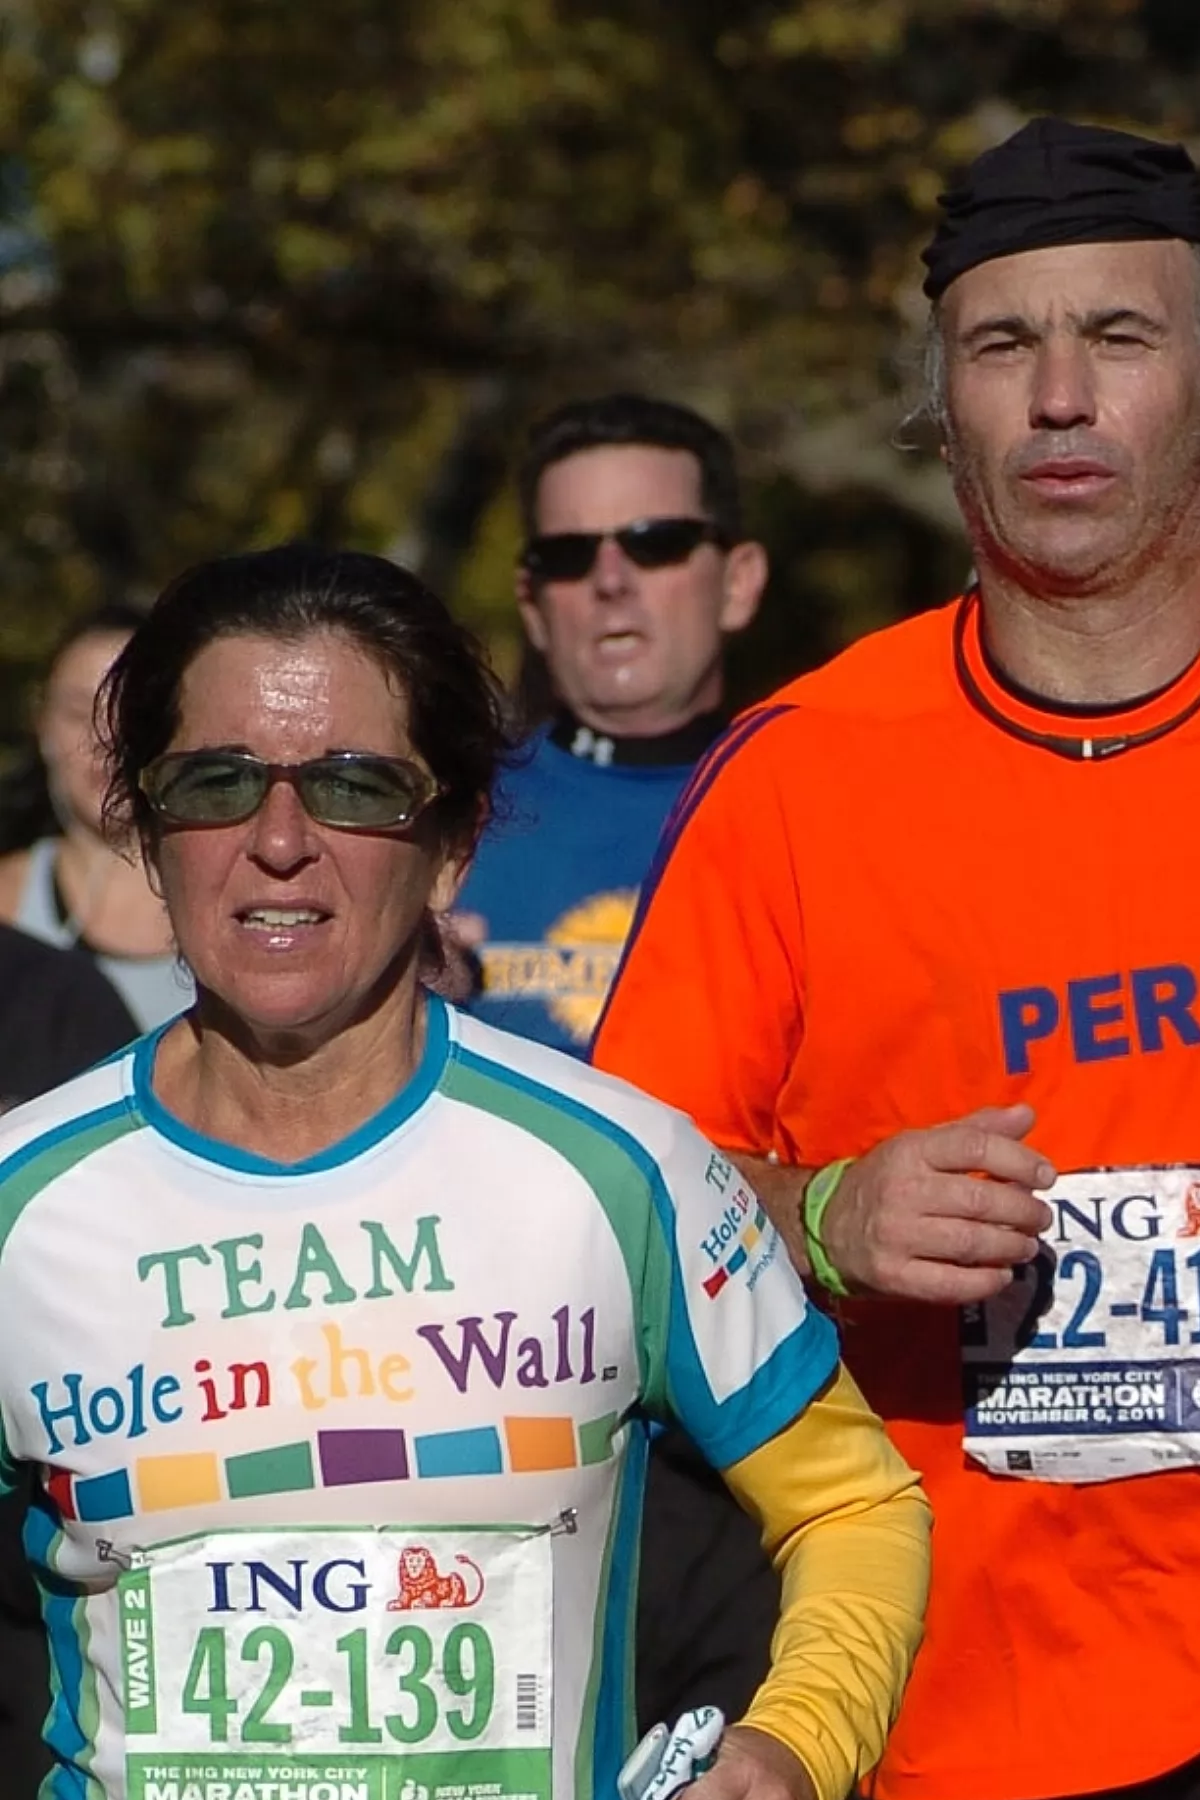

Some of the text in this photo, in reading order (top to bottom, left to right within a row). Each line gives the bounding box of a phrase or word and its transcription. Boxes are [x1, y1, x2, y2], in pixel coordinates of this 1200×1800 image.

[699, 1206, 741, 1264] Hole
[1049, 1194, 1165, 1242] NG
[138, 1214, 455, 1328] TEAM
[31, 1363, 184, 1455] Hole
[193, 1359, 271, 1423] in
[289, 1322, 416, 1412] the
[977, 1384, 1166, 1409] MARATHON
[1009, 1372, 1040, 1385] ING
[1042, 1372, 1079, 1385] NEW
[1082, 1372, 1123, 1384] YORK
[1124, 1370, 1164, 1384] CITY
[977, 1407, 1089, 1425] NOVEMBER
[1117, 1406, 1166, 1423] 2011
[204, 1557, 373, 1613] ING
[124, 1588, 150, 1710] WAVE 2
[181, 1621, 496, 1744] 42-139
[142, 1766, 369, 1780] THE ING NEW YORK CITY
